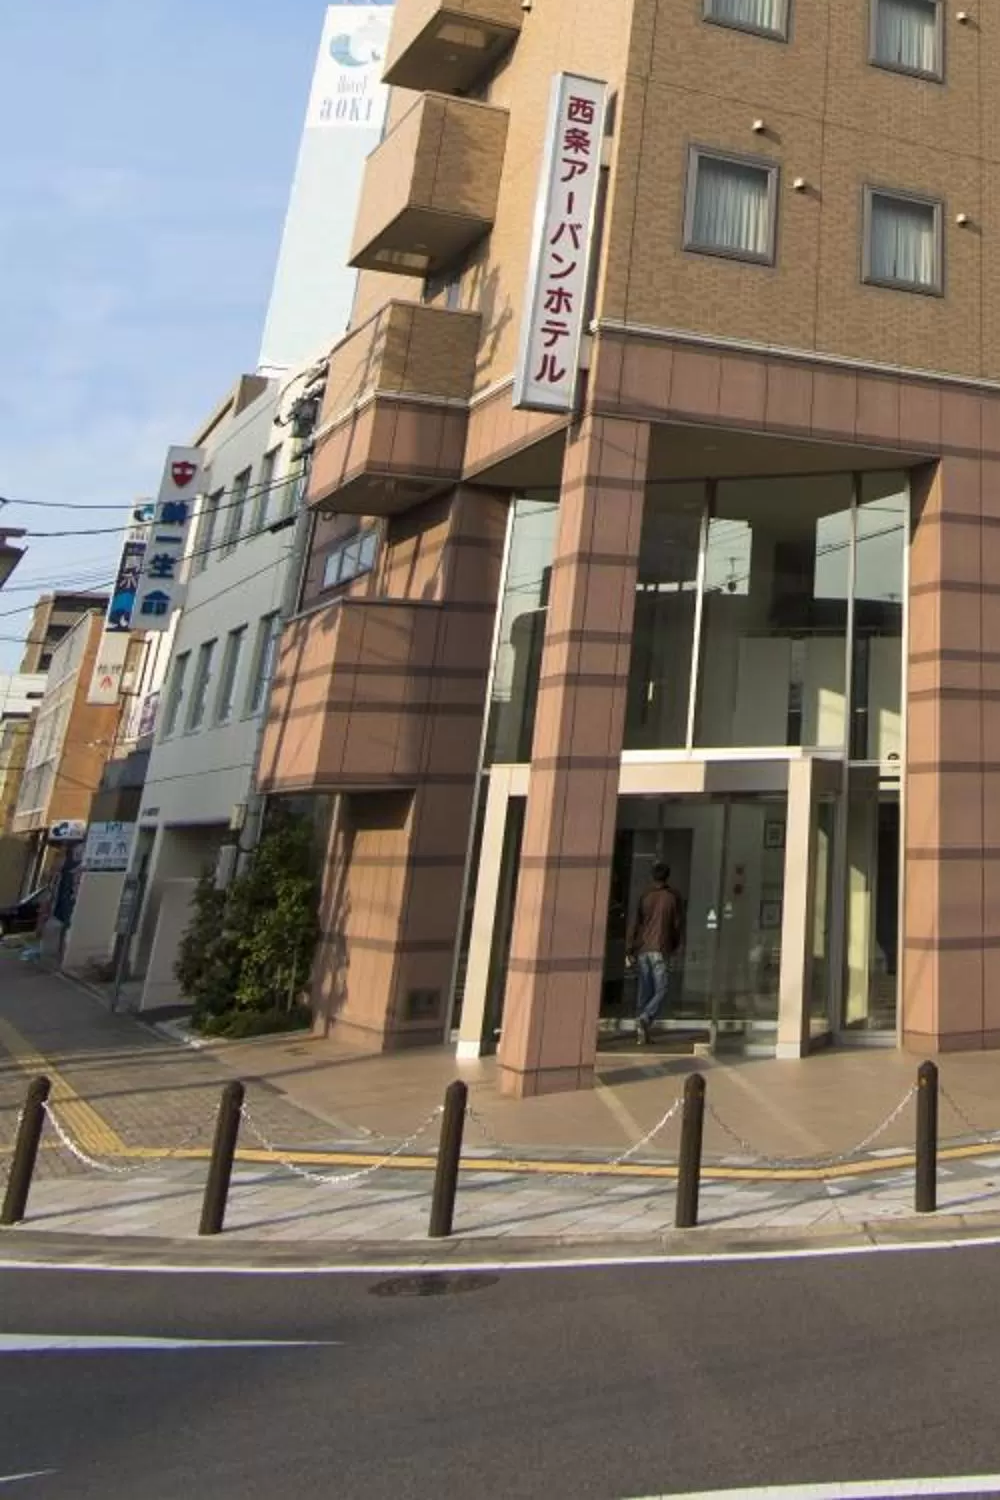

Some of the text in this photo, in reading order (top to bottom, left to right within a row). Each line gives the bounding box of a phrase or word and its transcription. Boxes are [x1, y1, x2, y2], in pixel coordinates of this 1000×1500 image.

[534, 95, 597, 385] 西条アーバンホテル
